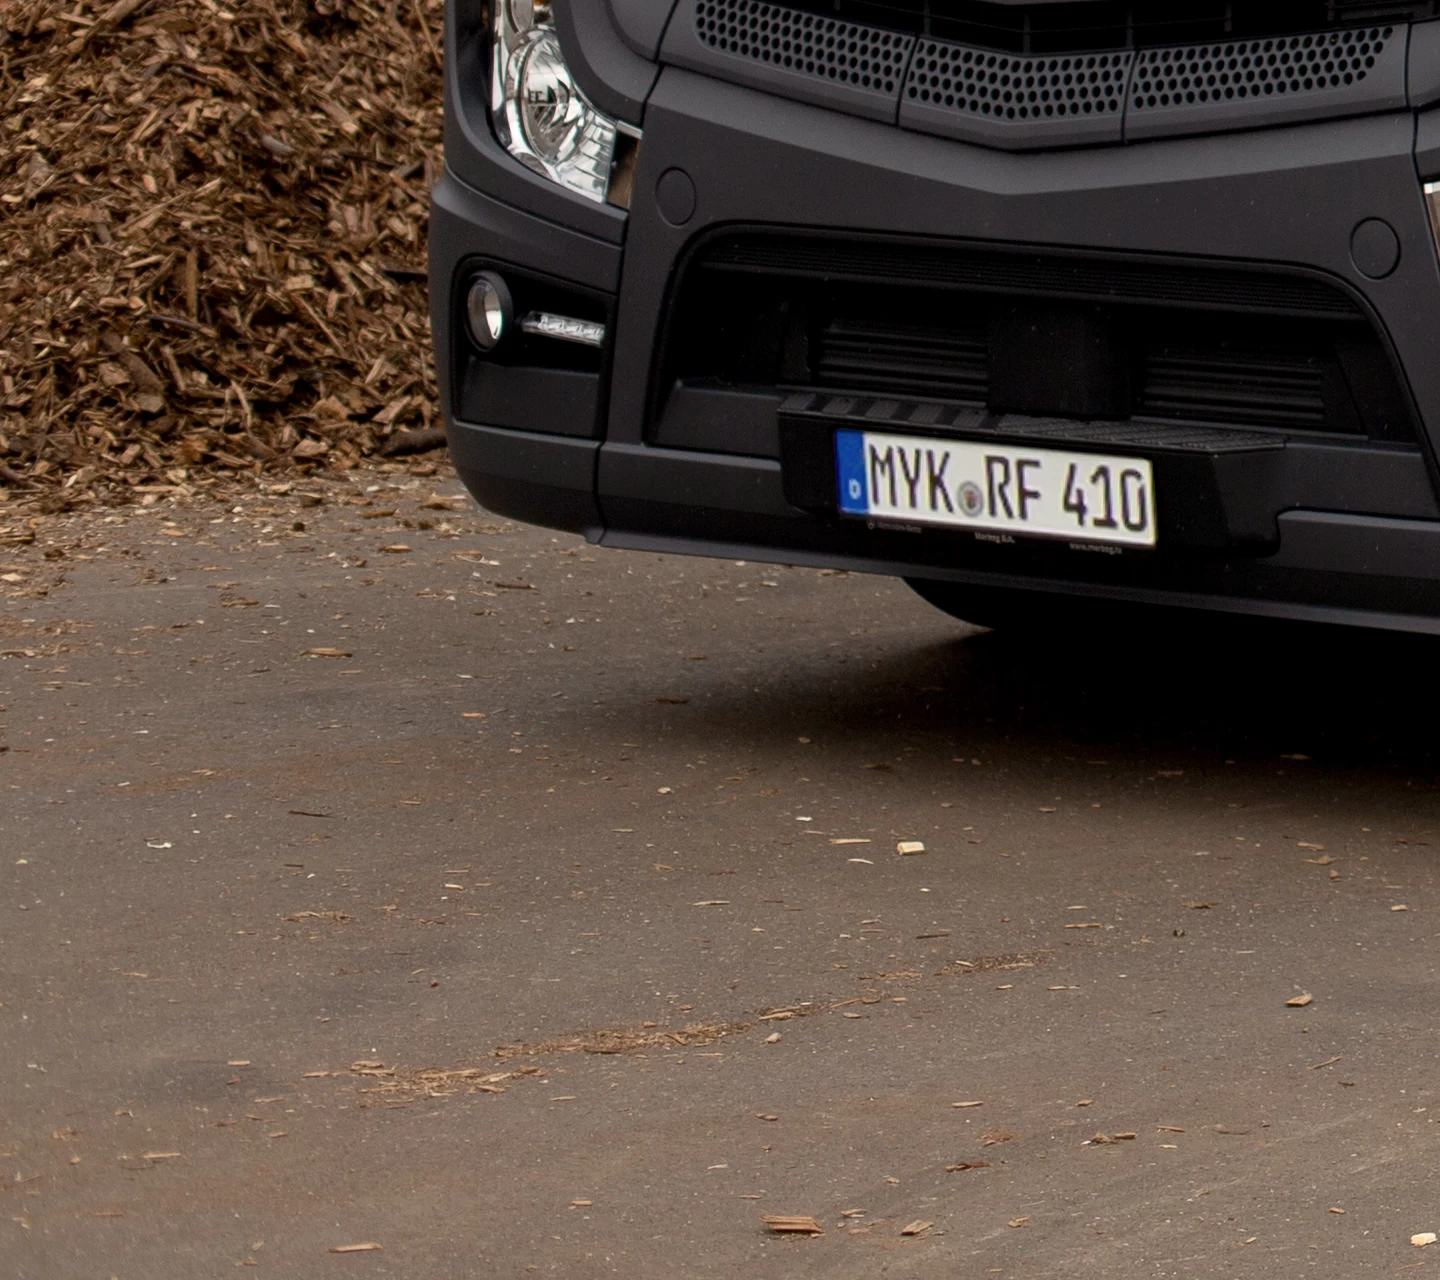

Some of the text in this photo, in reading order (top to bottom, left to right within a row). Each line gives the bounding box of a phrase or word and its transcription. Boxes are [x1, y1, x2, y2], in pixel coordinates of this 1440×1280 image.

[868, 443, 1148, 532] MYK RF 410
